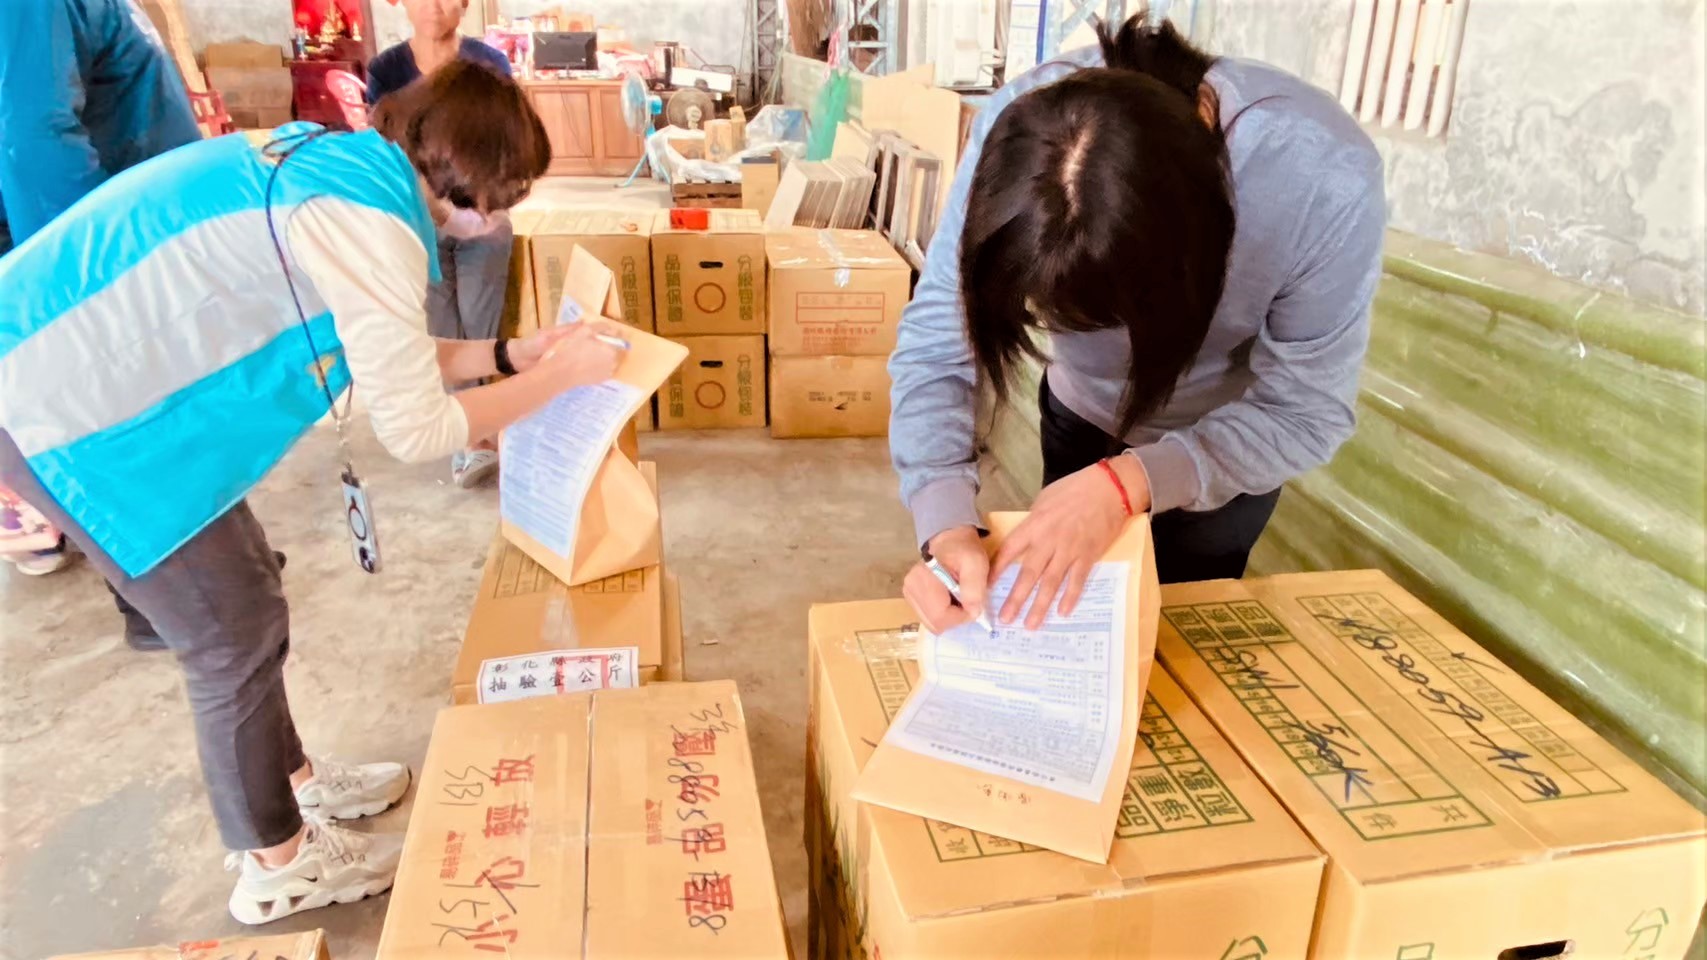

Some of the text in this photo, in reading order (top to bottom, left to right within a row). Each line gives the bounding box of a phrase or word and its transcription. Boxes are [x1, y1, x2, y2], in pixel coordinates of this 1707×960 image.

[466, 754, 535, 953] 小心輕放
[1131, 773, 1198, 824] 淨重
